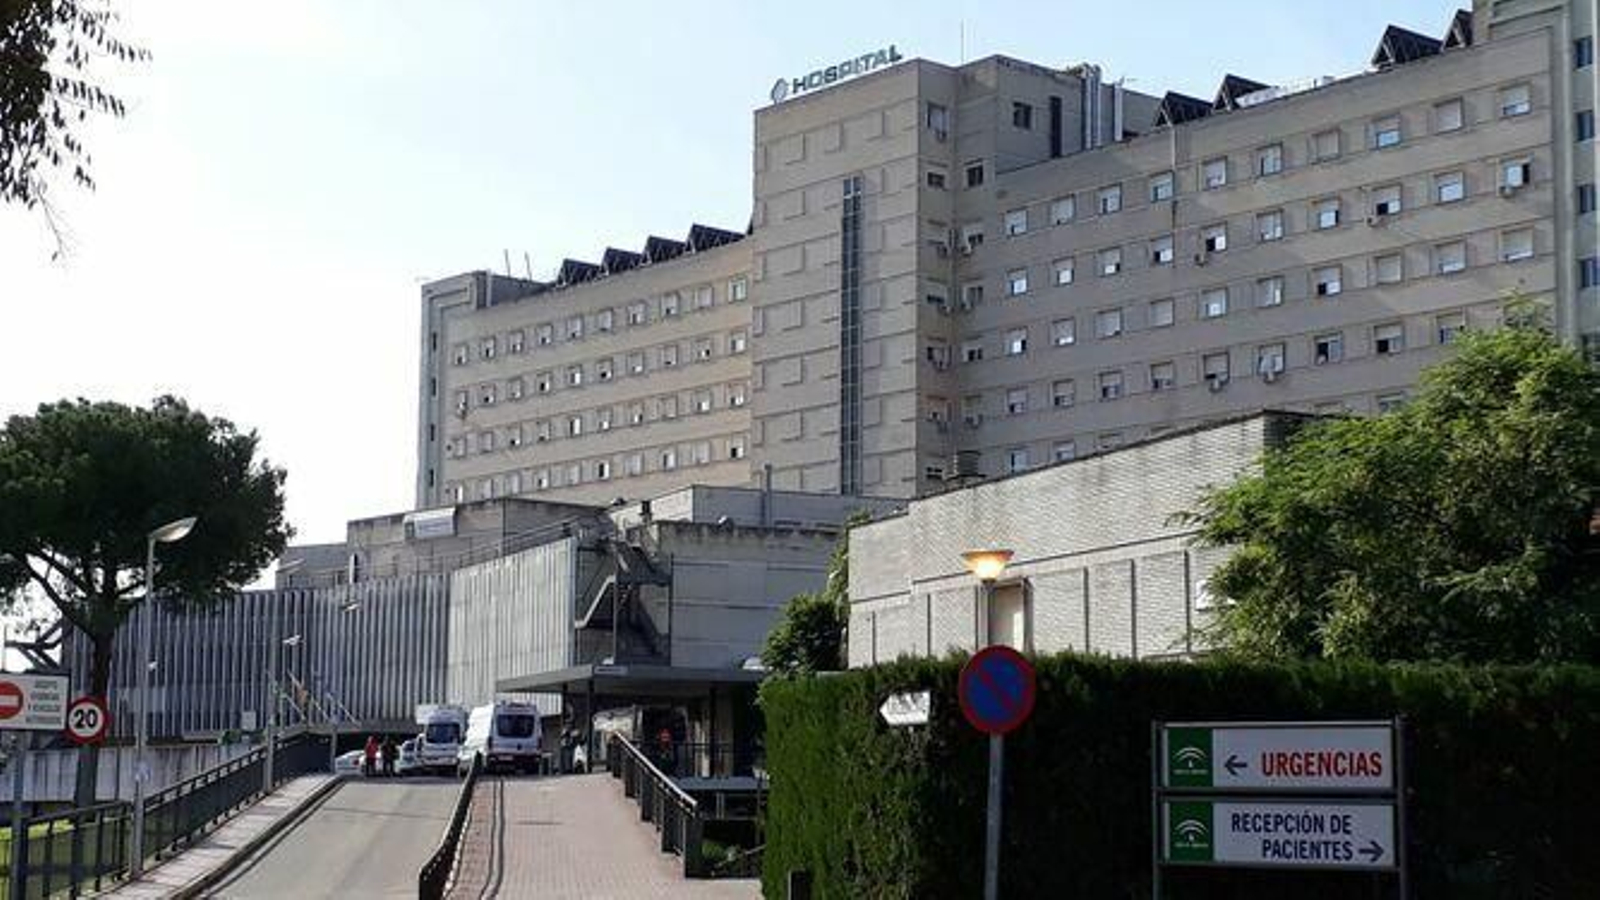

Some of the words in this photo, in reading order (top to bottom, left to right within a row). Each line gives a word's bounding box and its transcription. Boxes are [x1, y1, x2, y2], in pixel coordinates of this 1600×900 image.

[793, 44, 903, 93] HOSPITAL
[74, 709, 98, 729] 20
[1262, 751, 1382, 777] URGENCIAS
[1231, 811, 1325, 833] RECEPCIÓN
[1330, 815, 1352, 834] DE
[1262, 839, 1354, 861] PACIENTES
